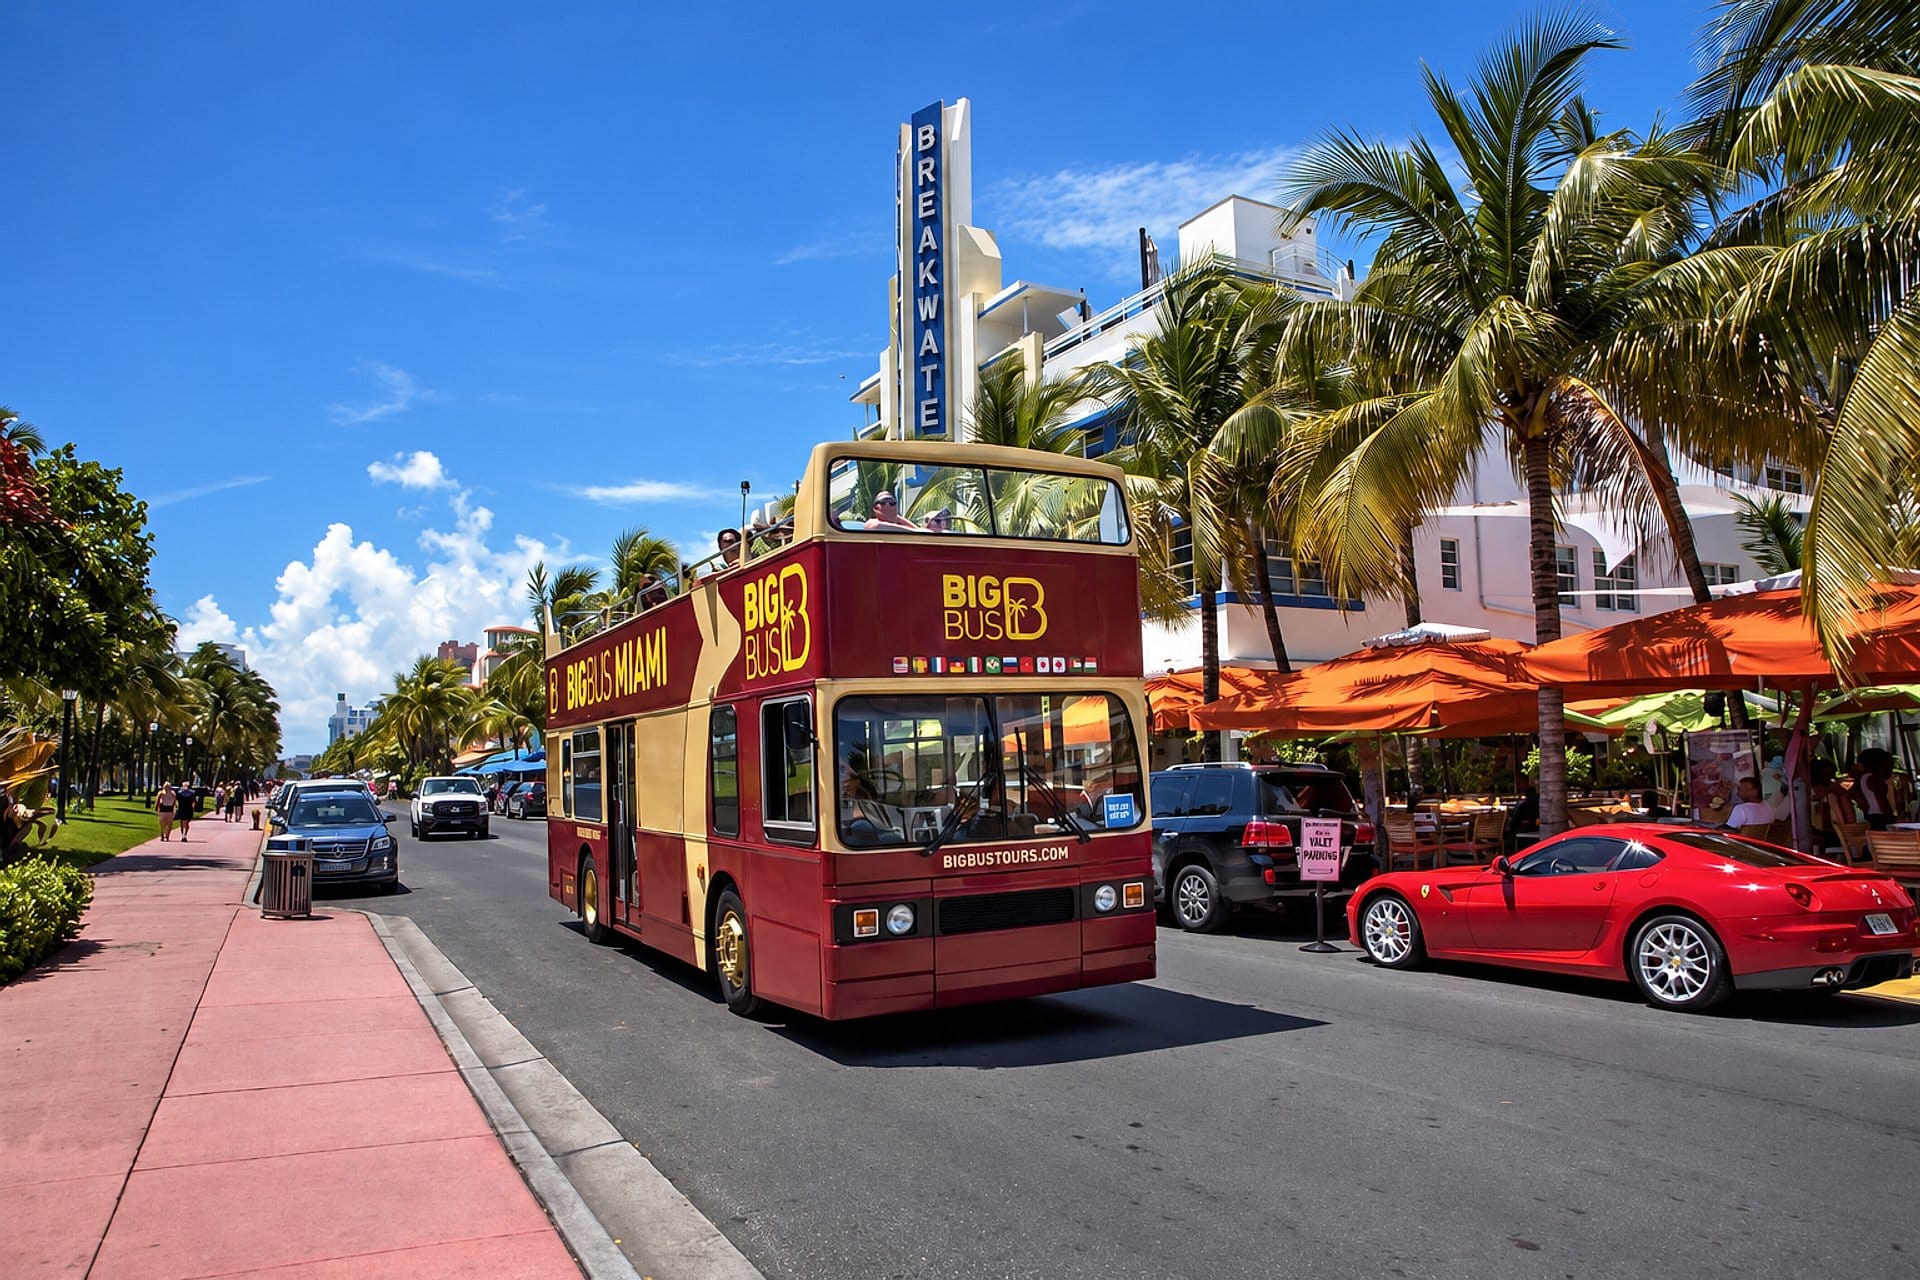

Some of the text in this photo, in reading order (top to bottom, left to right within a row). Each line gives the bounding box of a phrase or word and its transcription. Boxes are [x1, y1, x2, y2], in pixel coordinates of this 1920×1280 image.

[917, 124, 940, 428] BREAKWATE
[744, 573, 779, 632] BIG
[943, 574, 1000, 608] BIG
[945, 610, 1003, 640] BUS
[615, 626, 667, 699] MIAMI
[745, 627, 781, 681] BUS
[943, 846, 1069, 869] BIGBUSTOURS.COM
[1309, 837, 1333, 848] VALET
